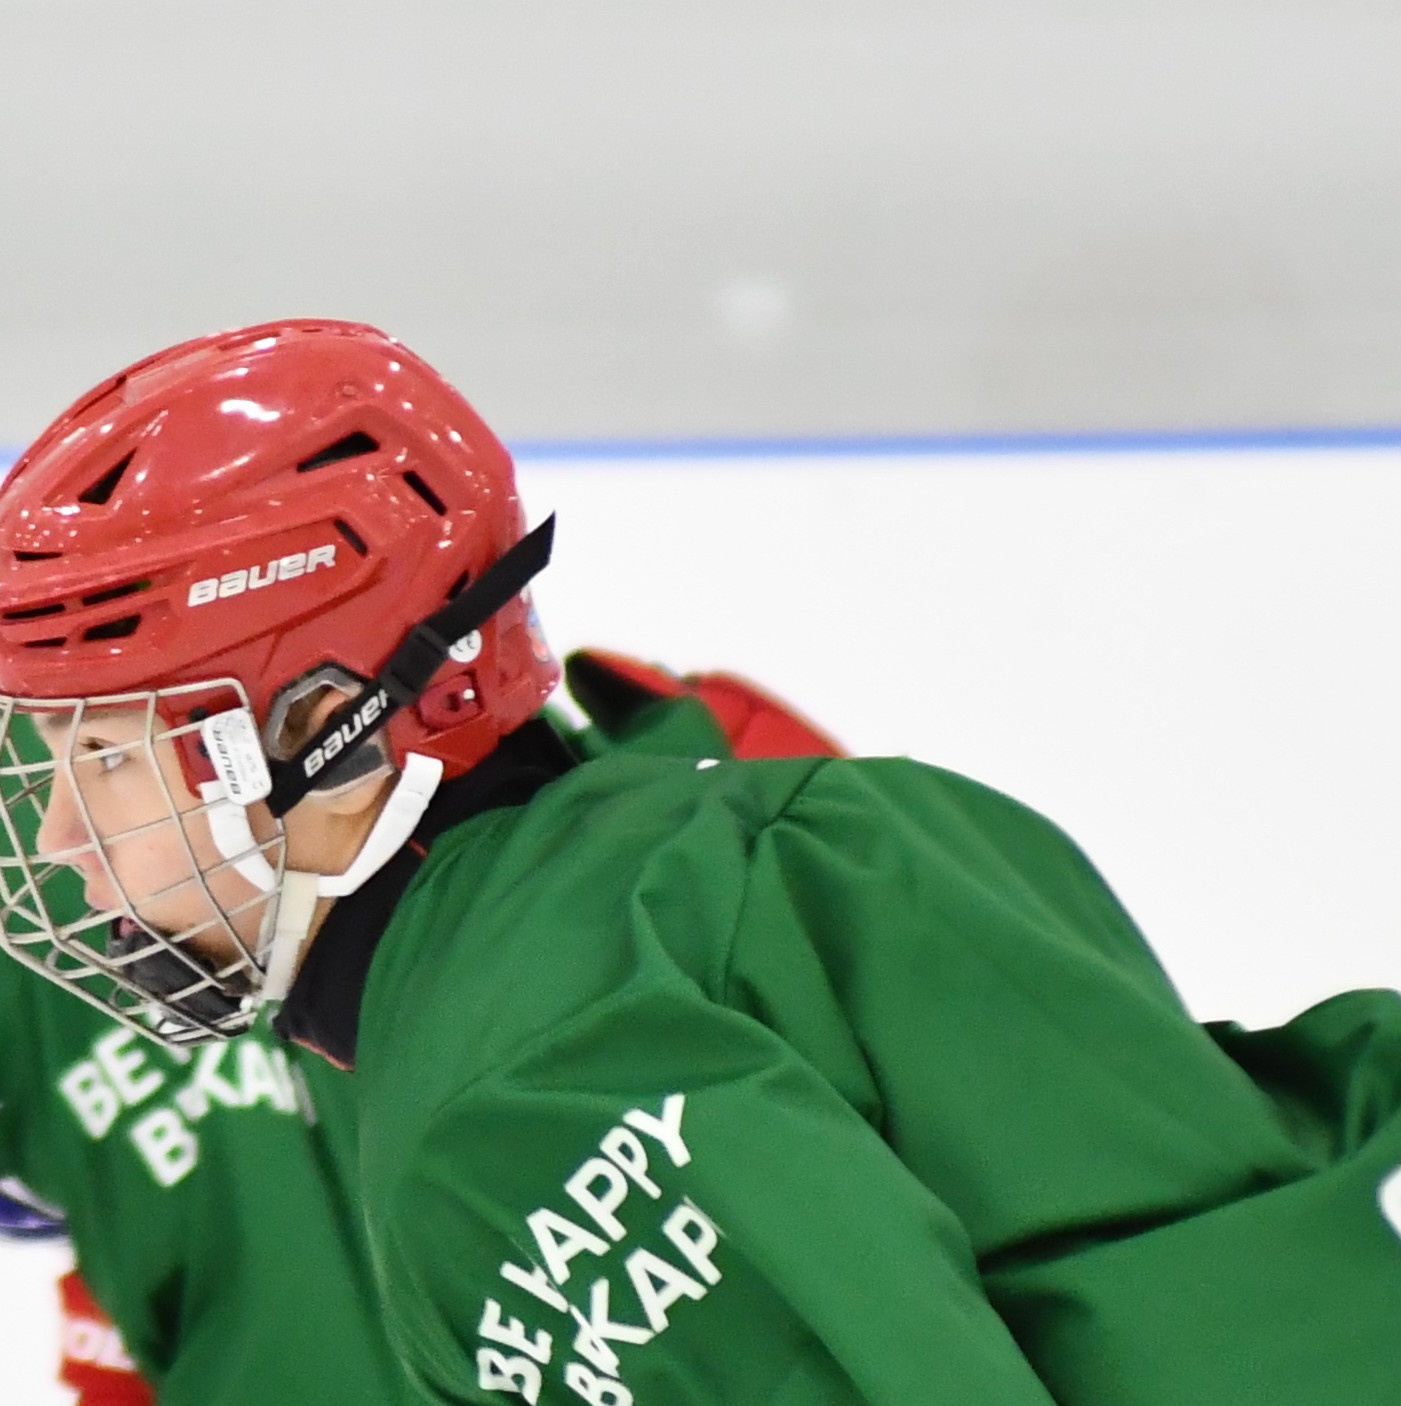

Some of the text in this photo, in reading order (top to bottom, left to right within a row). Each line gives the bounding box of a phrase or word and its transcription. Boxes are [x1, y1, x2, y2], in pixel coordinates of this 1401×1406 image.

[187, 544, 337, 608] BAUER
[59, 1026, 166, 1140] BE
[475, 1297, 553, 1406] BE
